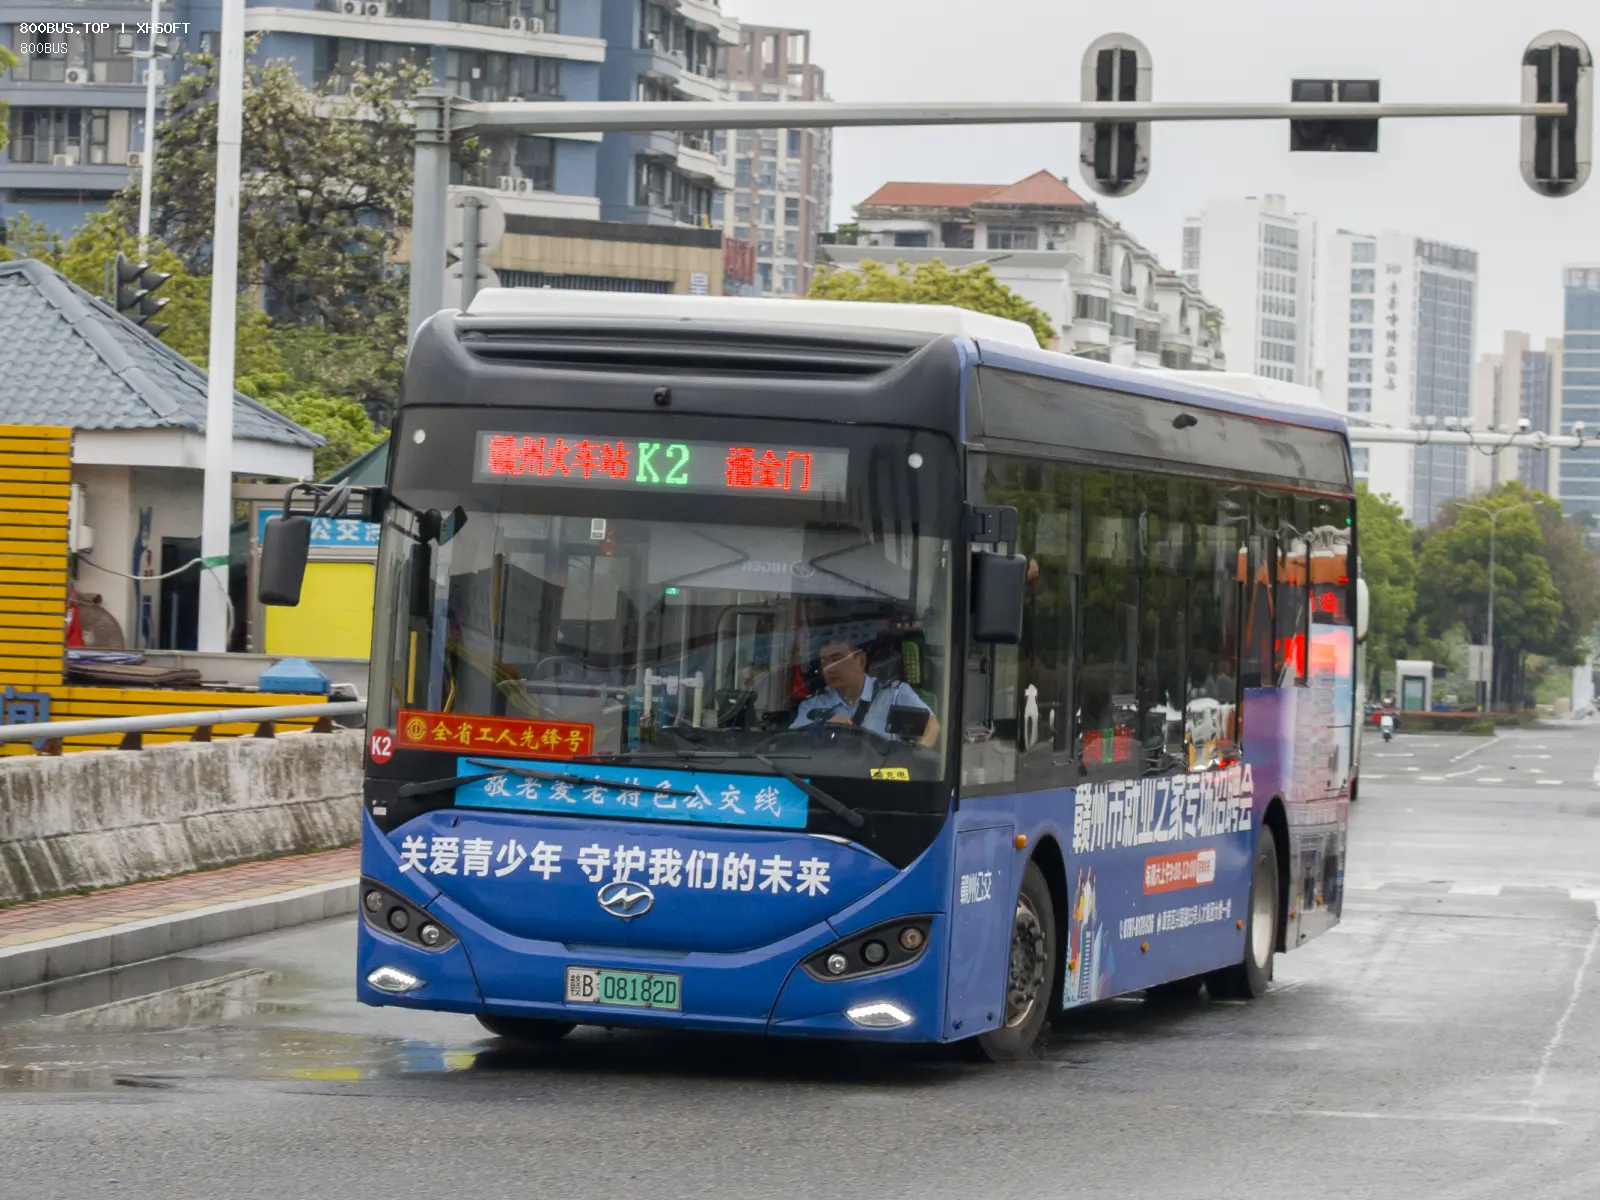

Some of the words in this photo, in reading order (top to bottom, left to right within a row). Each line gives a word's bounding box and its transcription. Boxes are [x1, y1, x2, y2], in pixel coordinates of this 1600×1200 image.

[487, 434, 630, 479] 赣州火车站
[635, 441, 691, 485] K2
[371, 735, 392, 757] K2
[431, 720, 585, 753] 全省工人先锋号
[483, 771, 782, 818] 敬老爱老特色公交线
[1072, 762, 1255, 854] 赣州市就业之家专场招聘会
[398, 835, 563, 880] 关爱青少年
[576, 842, 831, 897] 守护我们的未来
